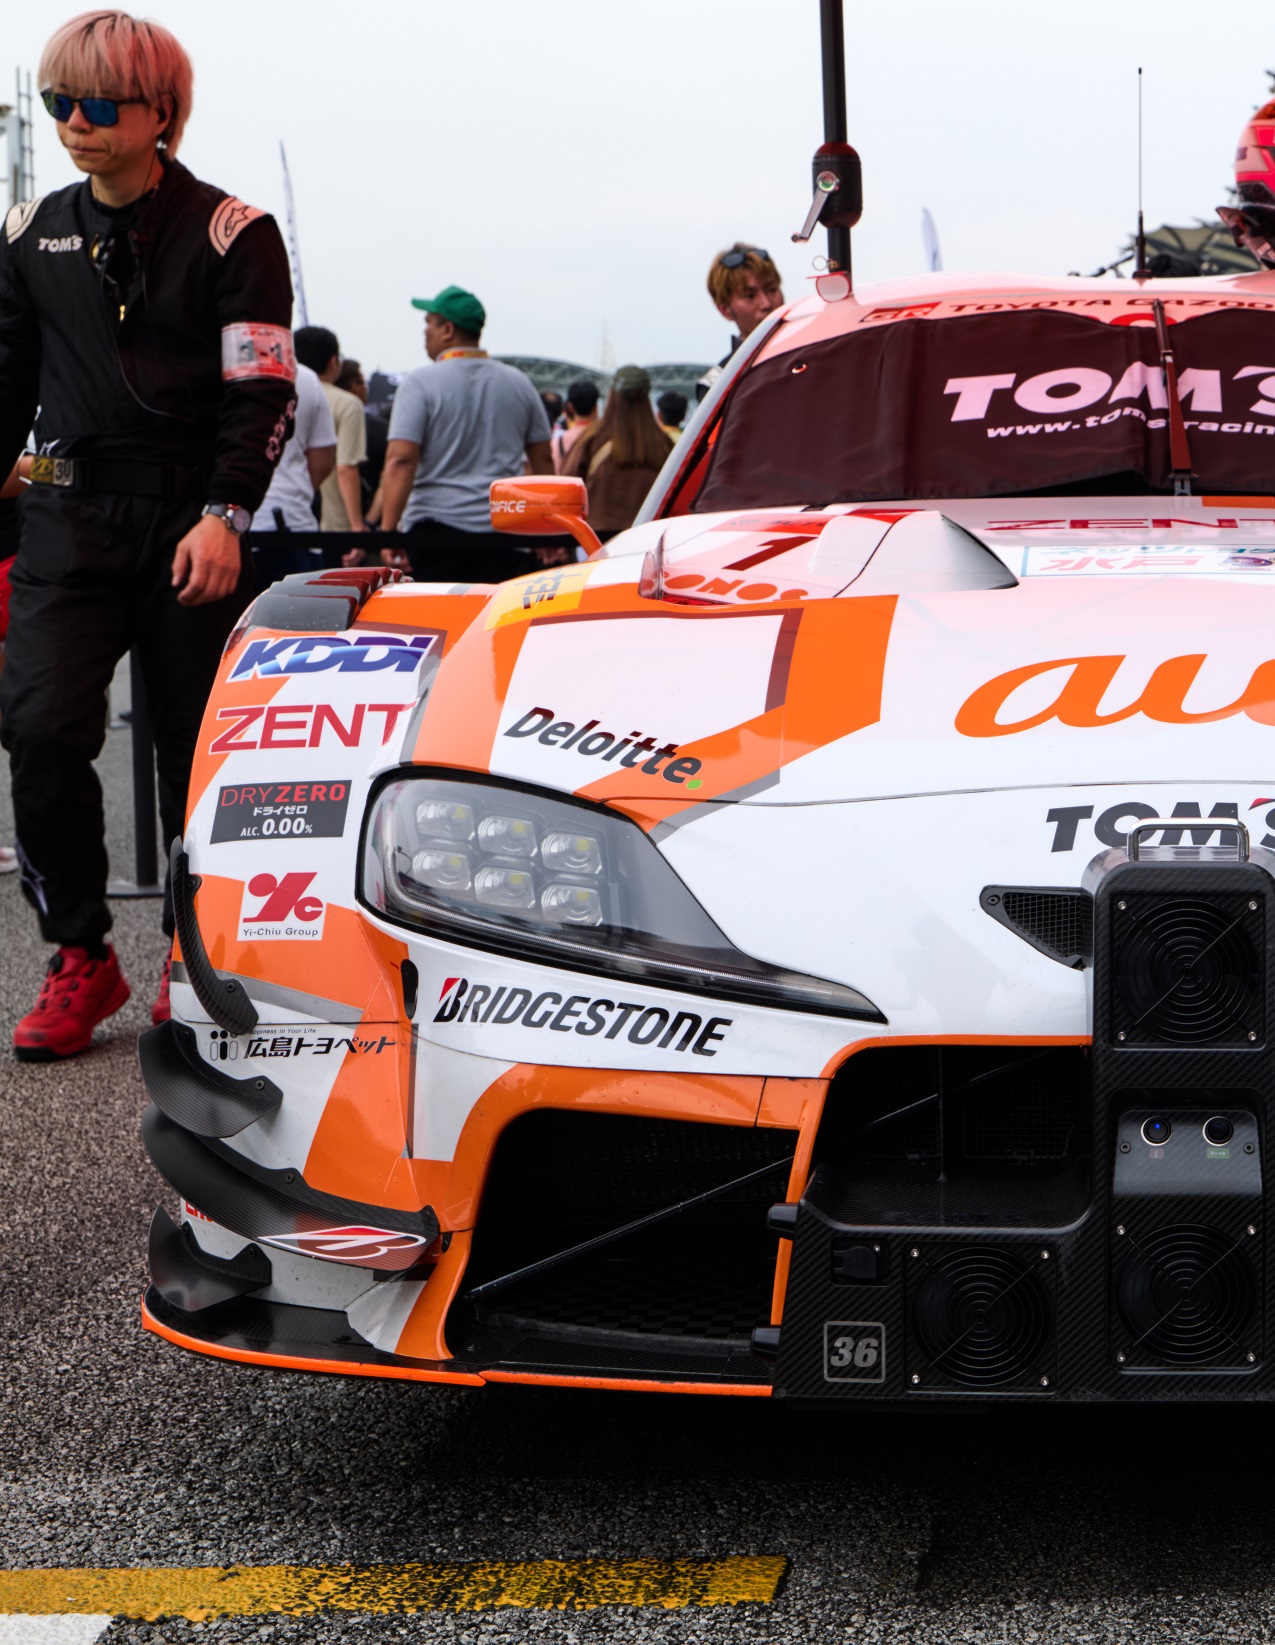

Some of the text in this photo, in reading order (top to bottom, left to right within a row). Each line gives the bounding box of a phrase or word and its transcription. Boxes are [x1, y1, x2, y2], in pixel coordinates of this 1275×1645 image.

[38, 235, 83, 252] TOM'S
[949, 299, 1105, 313] TOYOTA
[229, 636, 434, 681] KDDI
[210, 701, 418, 754] ZENT
[503, 706, 703, 790] Deloitte.
[253, 805, 307, 816] ドライゼロ
[240, 826, 260, 837] ALC.
[243, 927, 318, 937] Yi-Chiu Group
[433, 977, 733, 1057] BRIDGESTONE
[244, 1036, 397, 1058] 広島トヨペット
[830, 1336, 879, 1368] 36
